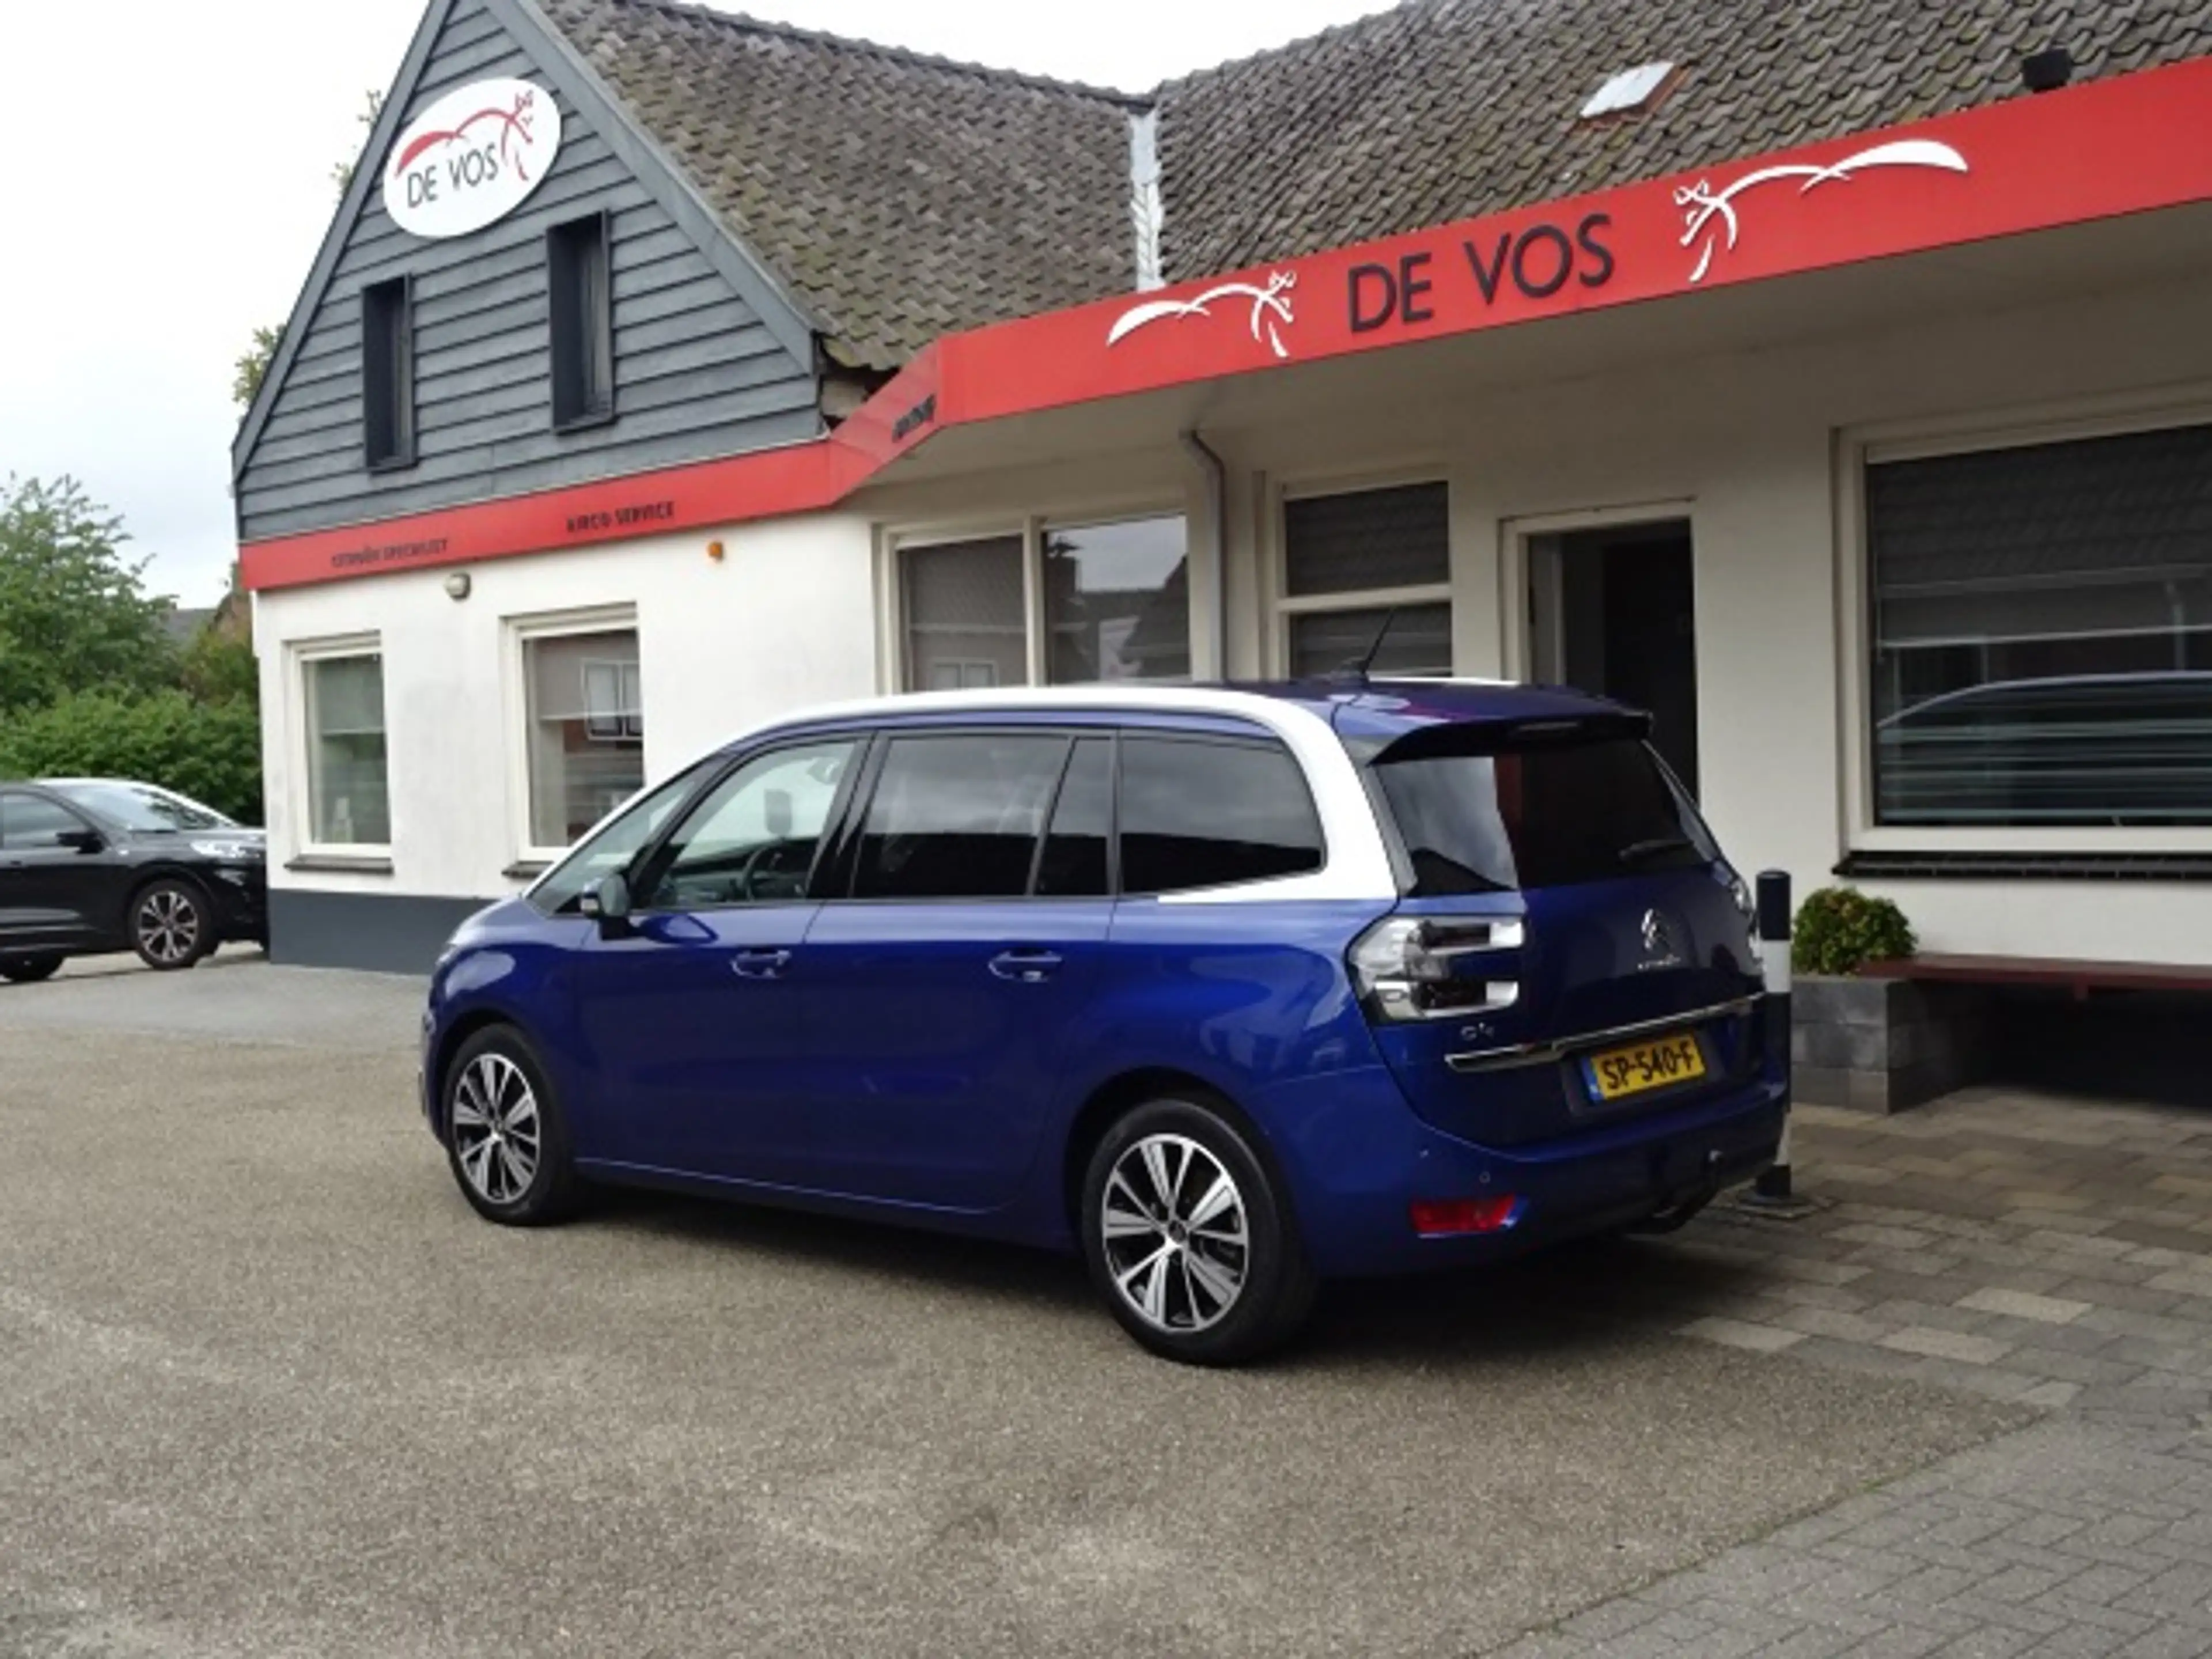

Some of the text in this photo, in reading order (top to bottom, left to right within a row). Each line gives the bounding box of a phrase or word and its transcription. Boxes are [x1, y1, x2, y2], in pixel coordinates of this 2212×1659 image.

[407, 142, 498, 209] DE VOS
[1347, 213, 1616, 333] DE VOS
[1601, 1040, 1695, 1090] SP-540-F
